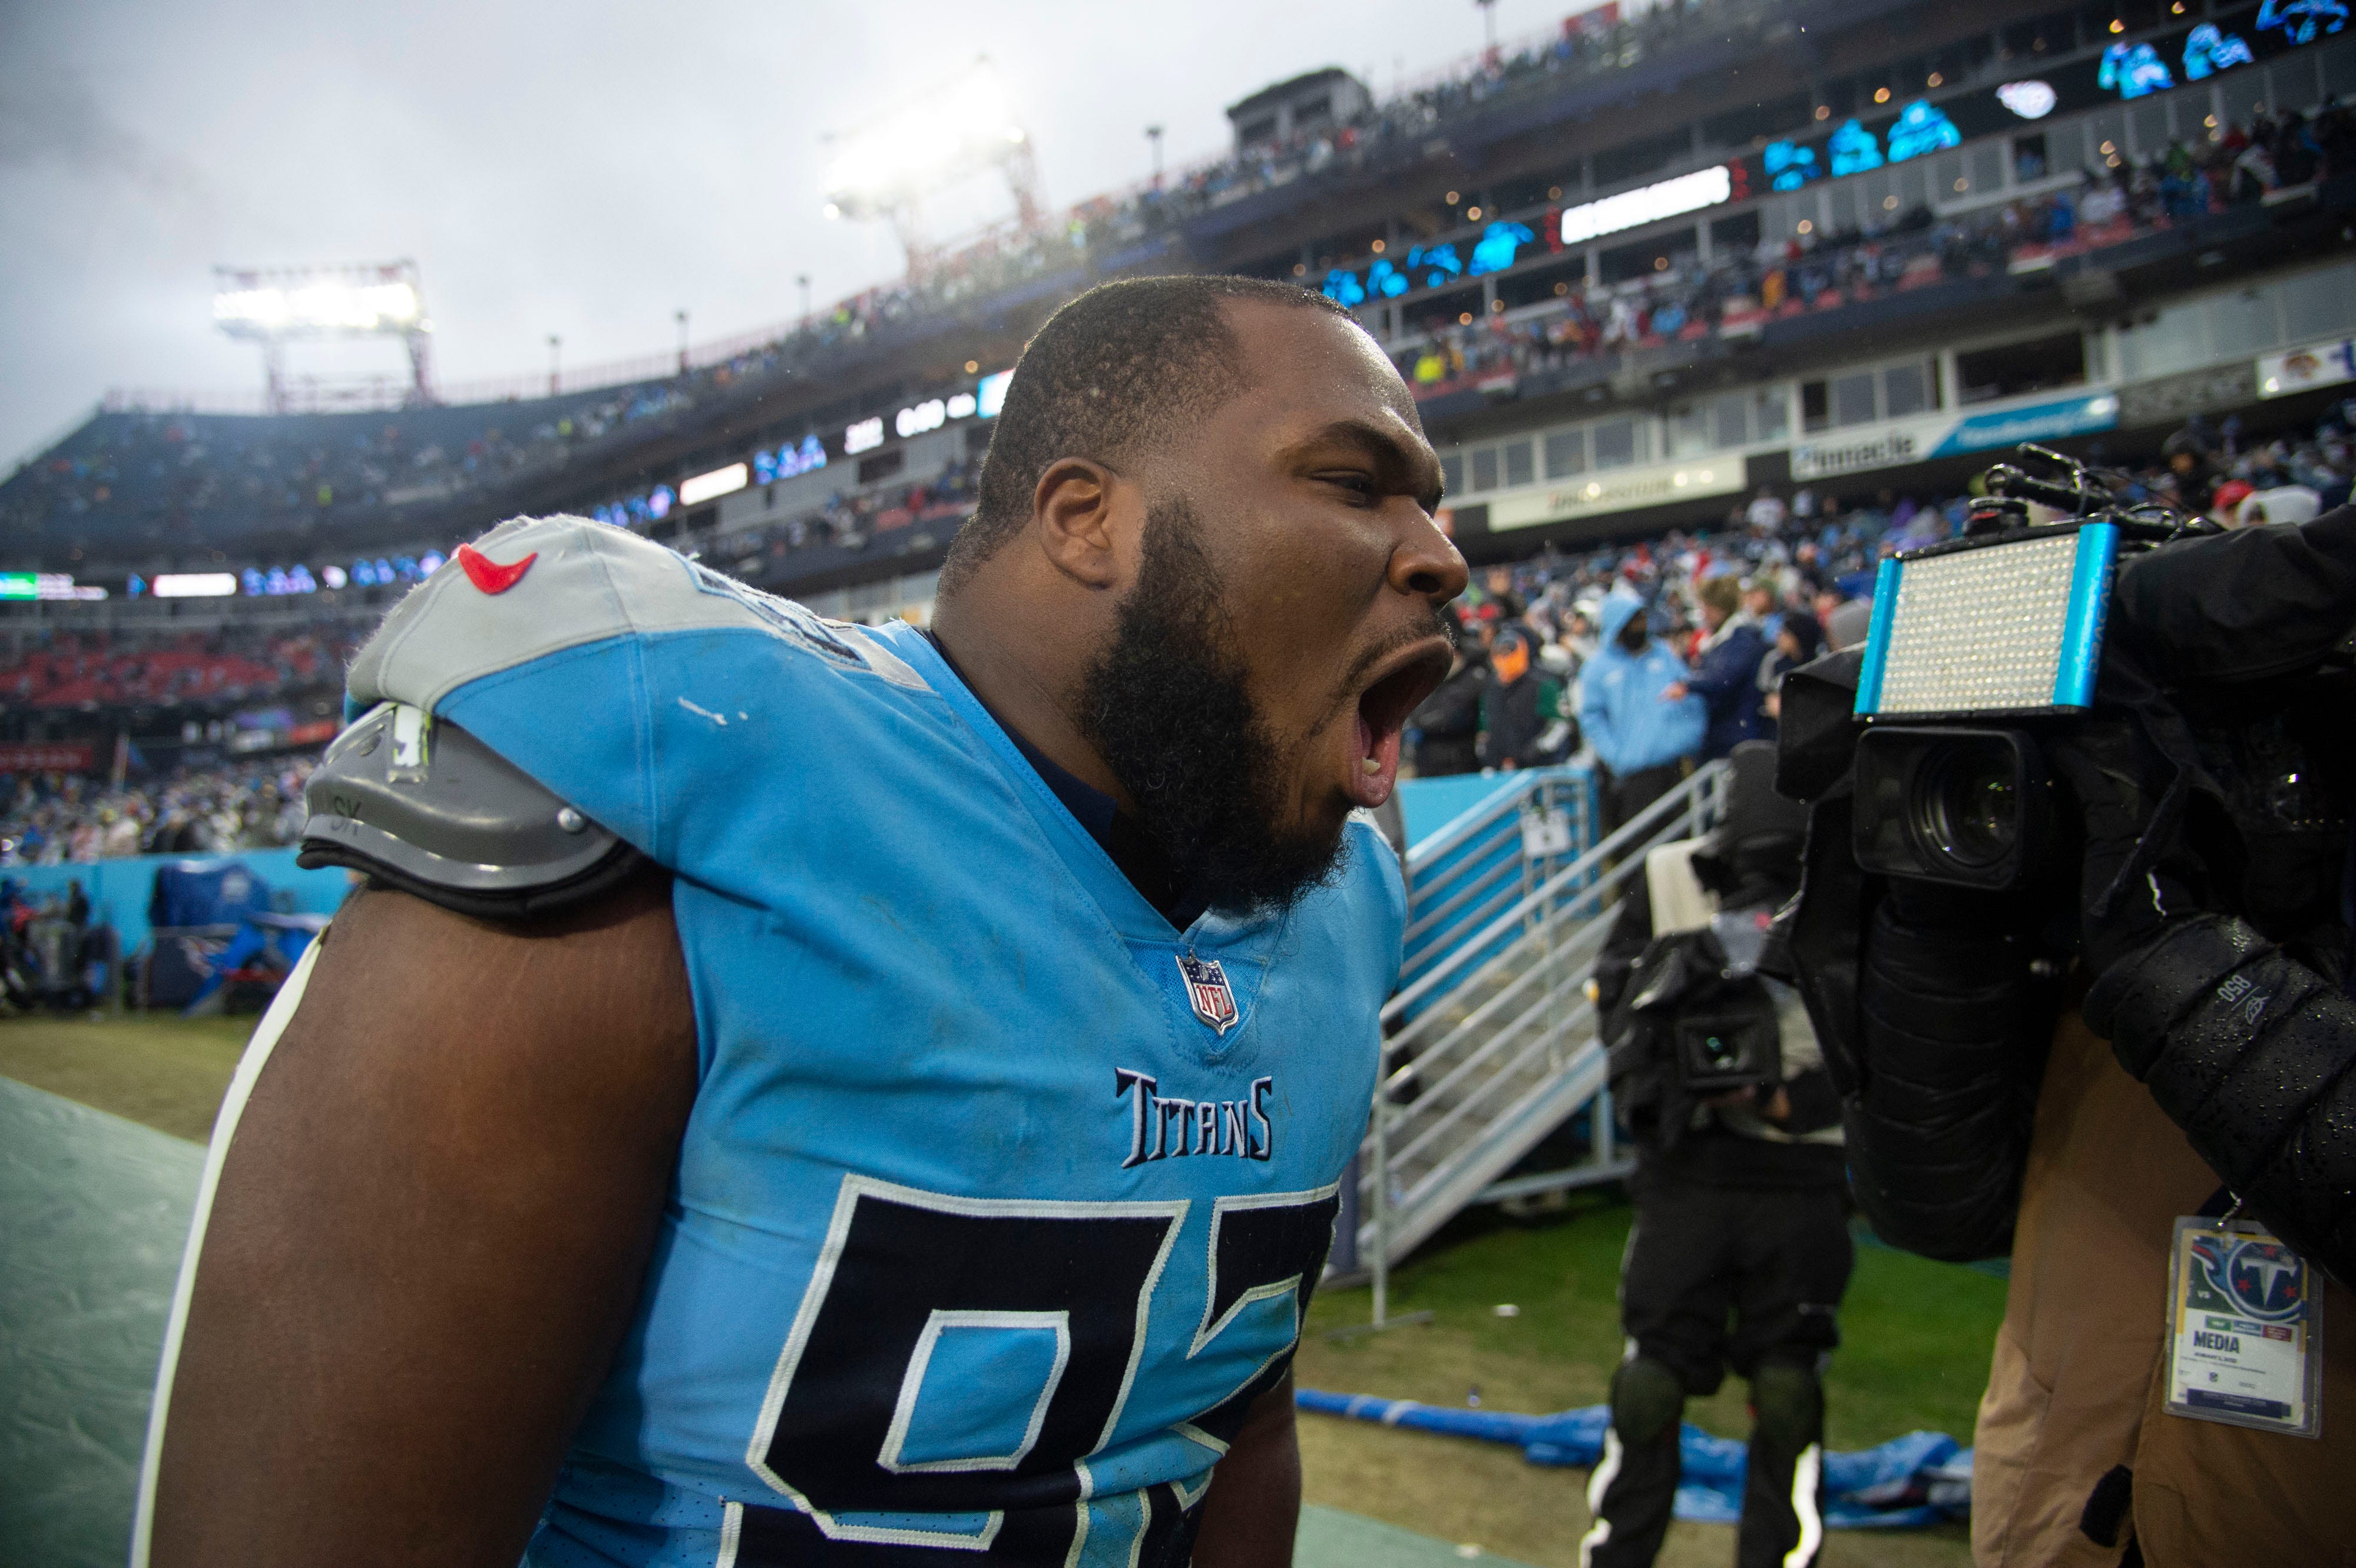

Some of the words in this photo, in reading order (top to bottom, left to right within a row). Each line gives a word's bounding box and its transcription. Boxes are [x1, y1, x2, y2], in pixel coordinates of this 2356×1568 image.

[1196, 984, 1232, 1018] NFL
[2217, 975, 2251, 1001] 850
[2193, 1330, 2241, 1354] MEDIA
